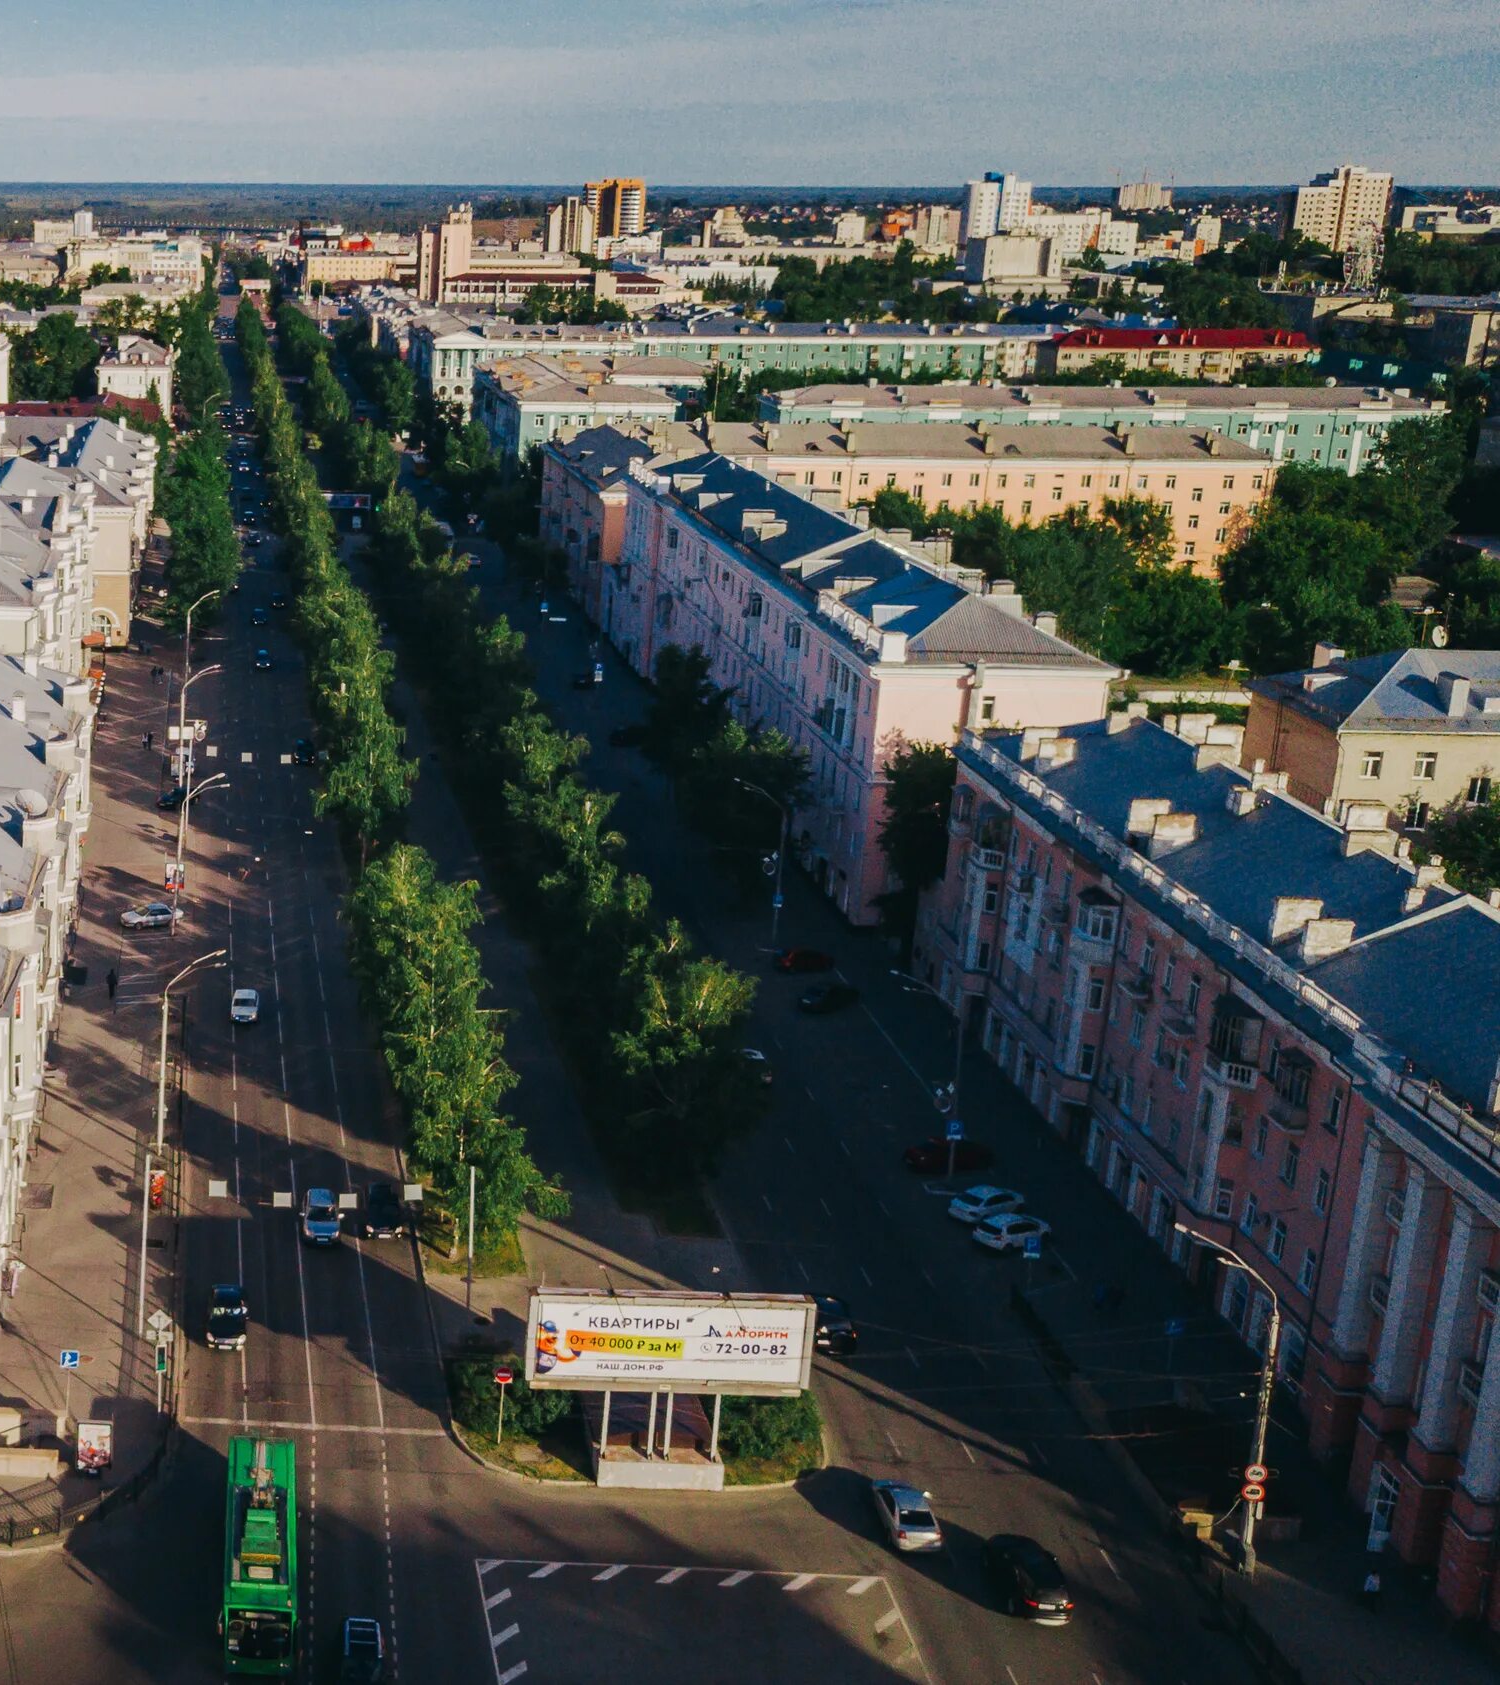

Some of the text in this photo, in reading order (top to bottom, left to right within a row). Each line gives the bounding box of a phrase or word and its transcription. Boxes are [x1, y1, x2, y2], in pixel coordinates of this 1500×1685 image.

[588, 1316, 680, 1330] КВАРТИРЫ
[725, 1330, 789, 1339] АЛГОРИТМ
[570, 1334, 585, 1345] От
[589, 1336, 605, 1347] 40
[609, 1338, 633, 1349] 000
[648, 1342, 661, 1351] за
[716, 1343, 787, 1355] 72-00-82
[596, 1363, 664, 1371] НАШ.ДОМ.РФ
